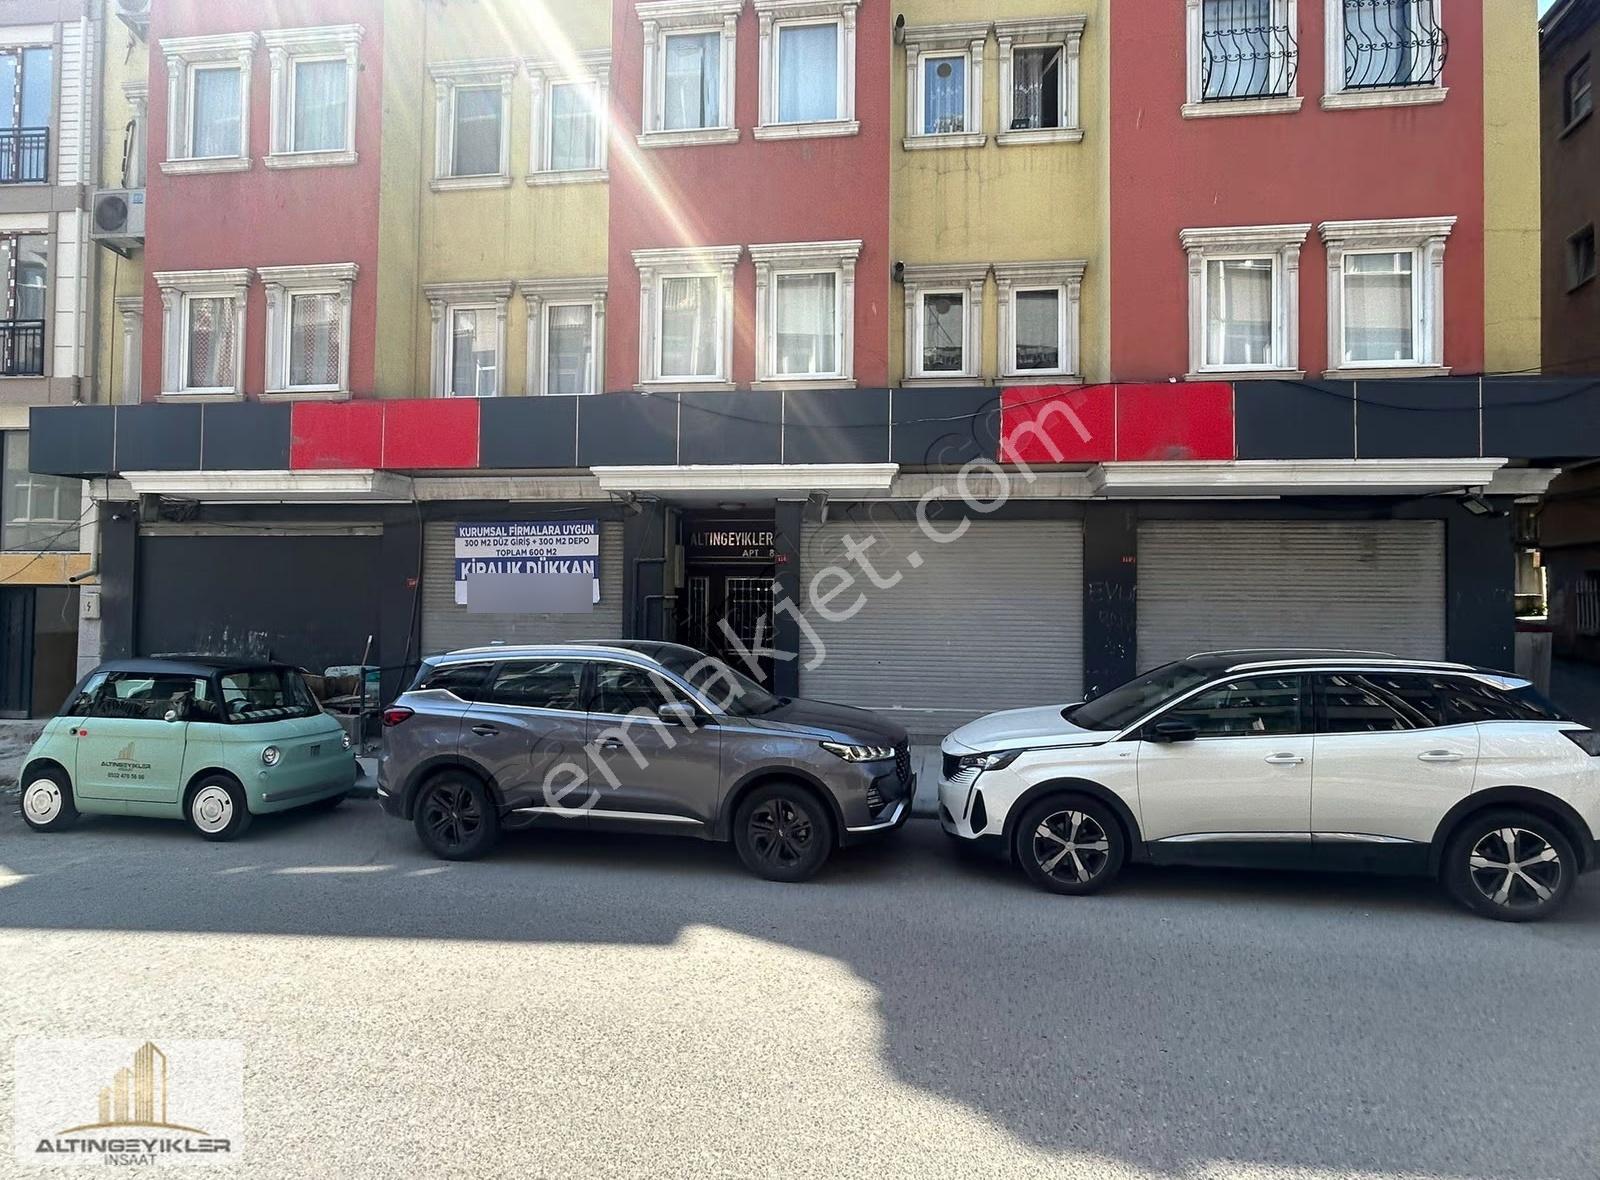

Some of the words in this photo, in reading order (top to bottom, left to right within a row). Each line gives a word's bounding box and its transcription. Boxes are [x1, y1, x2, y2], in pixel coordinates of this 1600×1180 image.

[459, 526, 507, 537] KURUMSAL
[509, 523, 560, 536] FİRMALARA
[563, 524, 594, 535] UYGUN
[464, 539, 479, 547] 300
[493, 537, 509, 546] DÜZ
[539, 538, 553, 546] 300
[555, 537, 566, 545] M2
[568, 536, 589, 545] DEPO
[496, 549, 527, 557] TOPLAM
[529, 548, 544, 556] 600
[546, 548, 557, 556] M2
[742, 549, 759, 558] APT
